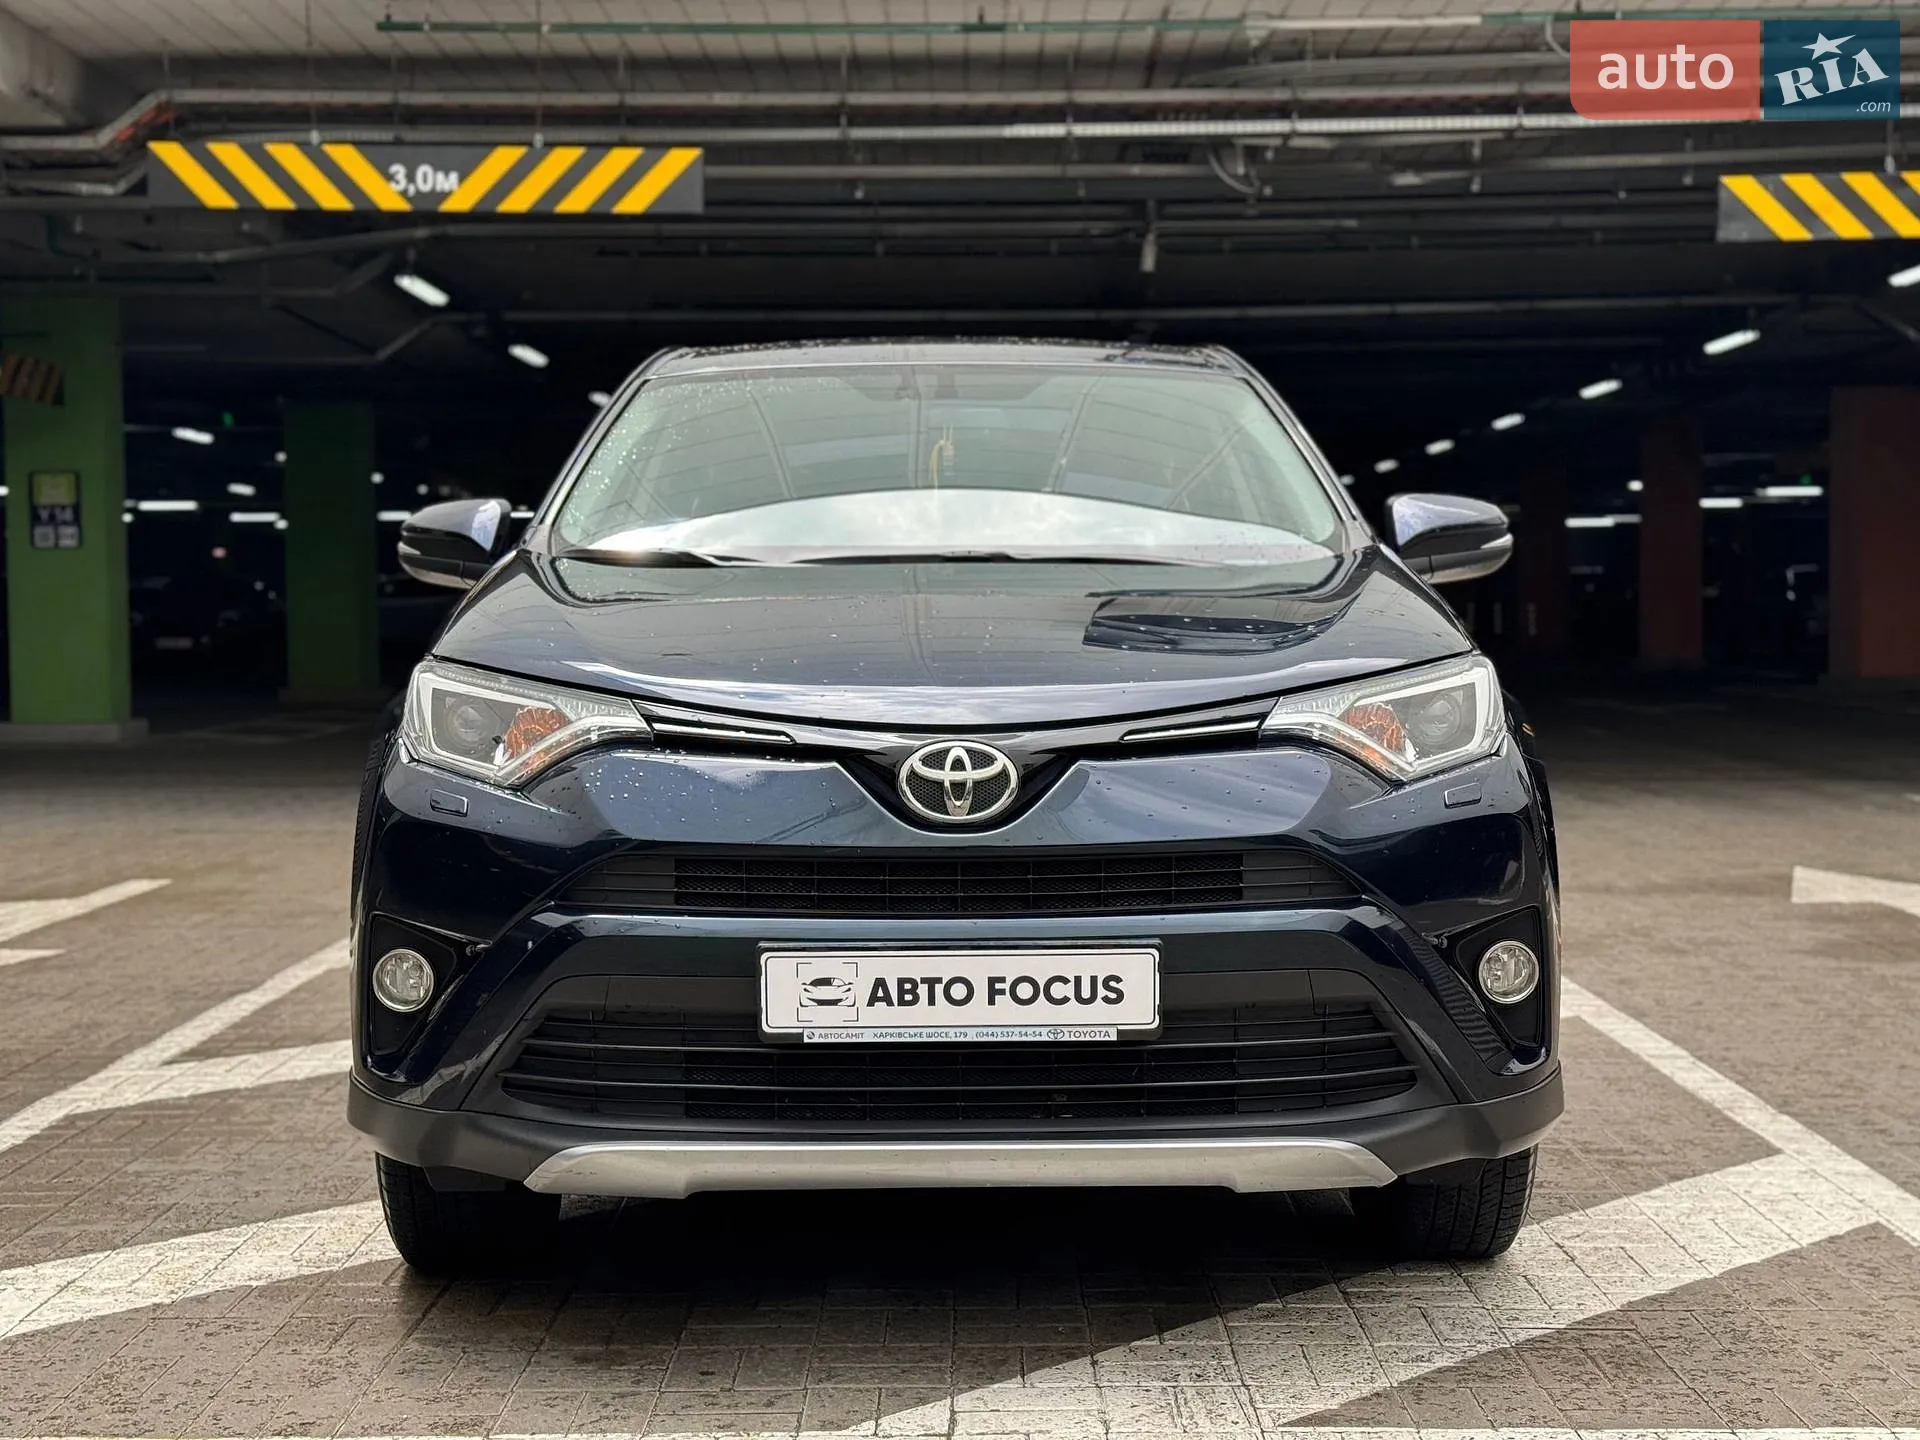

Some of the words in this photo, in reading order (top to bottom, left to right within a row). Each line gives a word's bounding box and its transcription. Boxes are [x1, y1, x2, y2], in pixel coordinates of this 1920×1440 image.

[866, 976, 975, 1007] АВТО
[987, 974, 1125, 1007] FOCUS
[872, 1031, 924, 1039] ХАРКІВСЬКЕ
[975, 1030, 999, 1040] (044)
[1000, 1030, 1042, 1038] 537-54-54
[1067, 1030, 1111, 1039] TOYOTA
